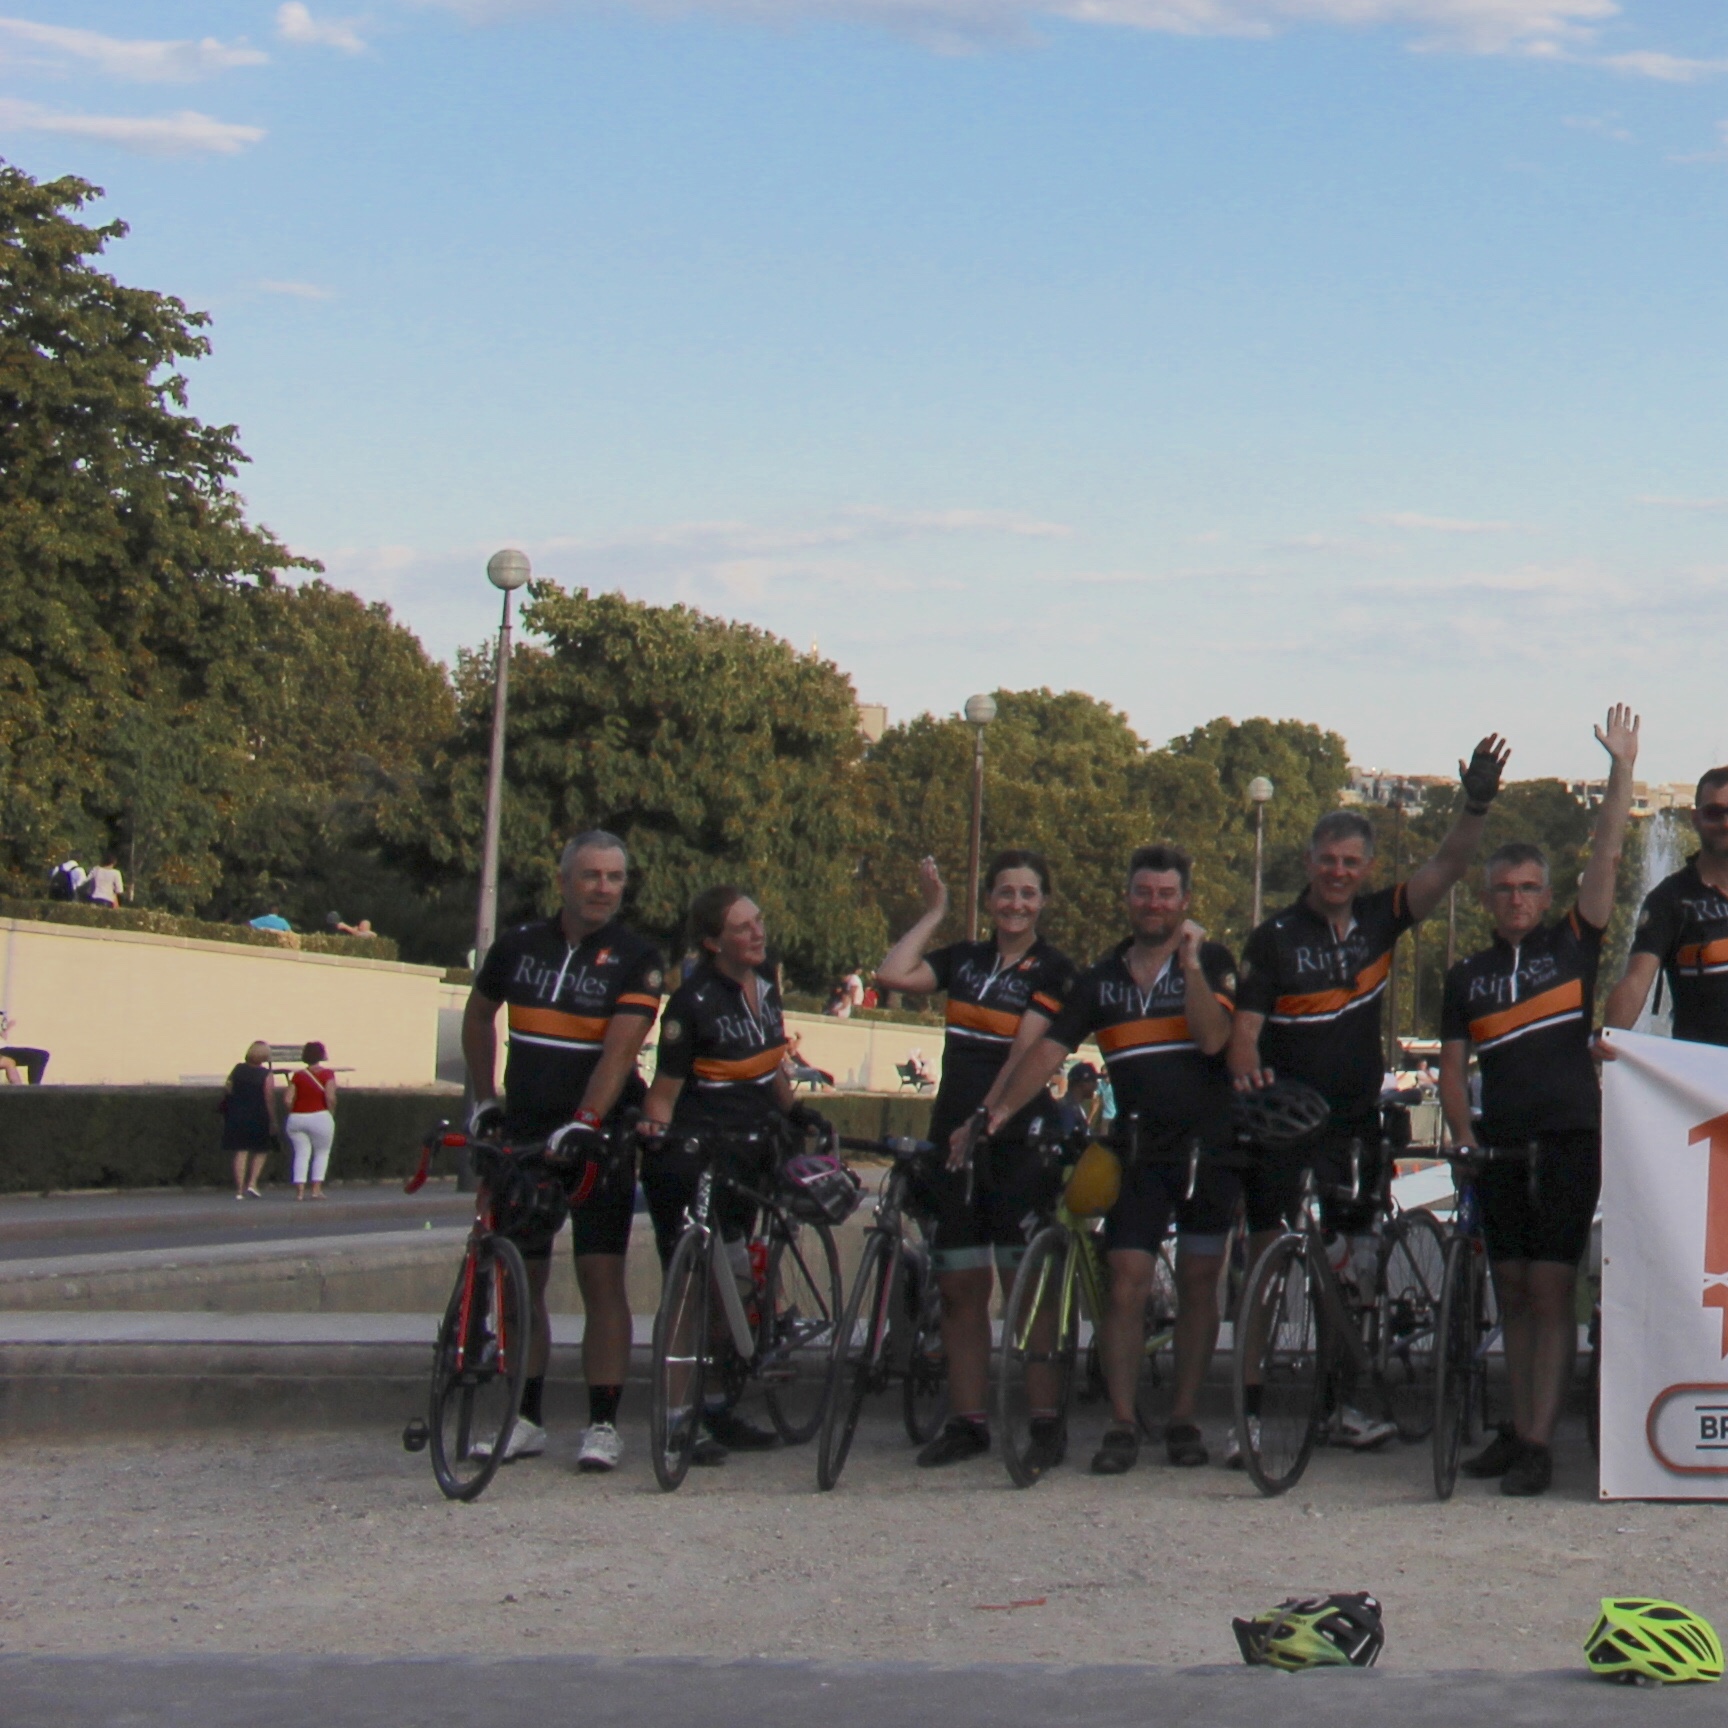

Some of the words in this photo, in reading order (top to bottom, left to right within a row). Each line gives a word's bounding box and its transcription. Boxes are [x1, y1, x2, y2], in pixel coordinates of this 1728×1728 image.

[512, 954, 611, 1000] Ripples
[957, 959, 1031, 997] Riples
[1468, 953, 1556, 1004] Ripes
